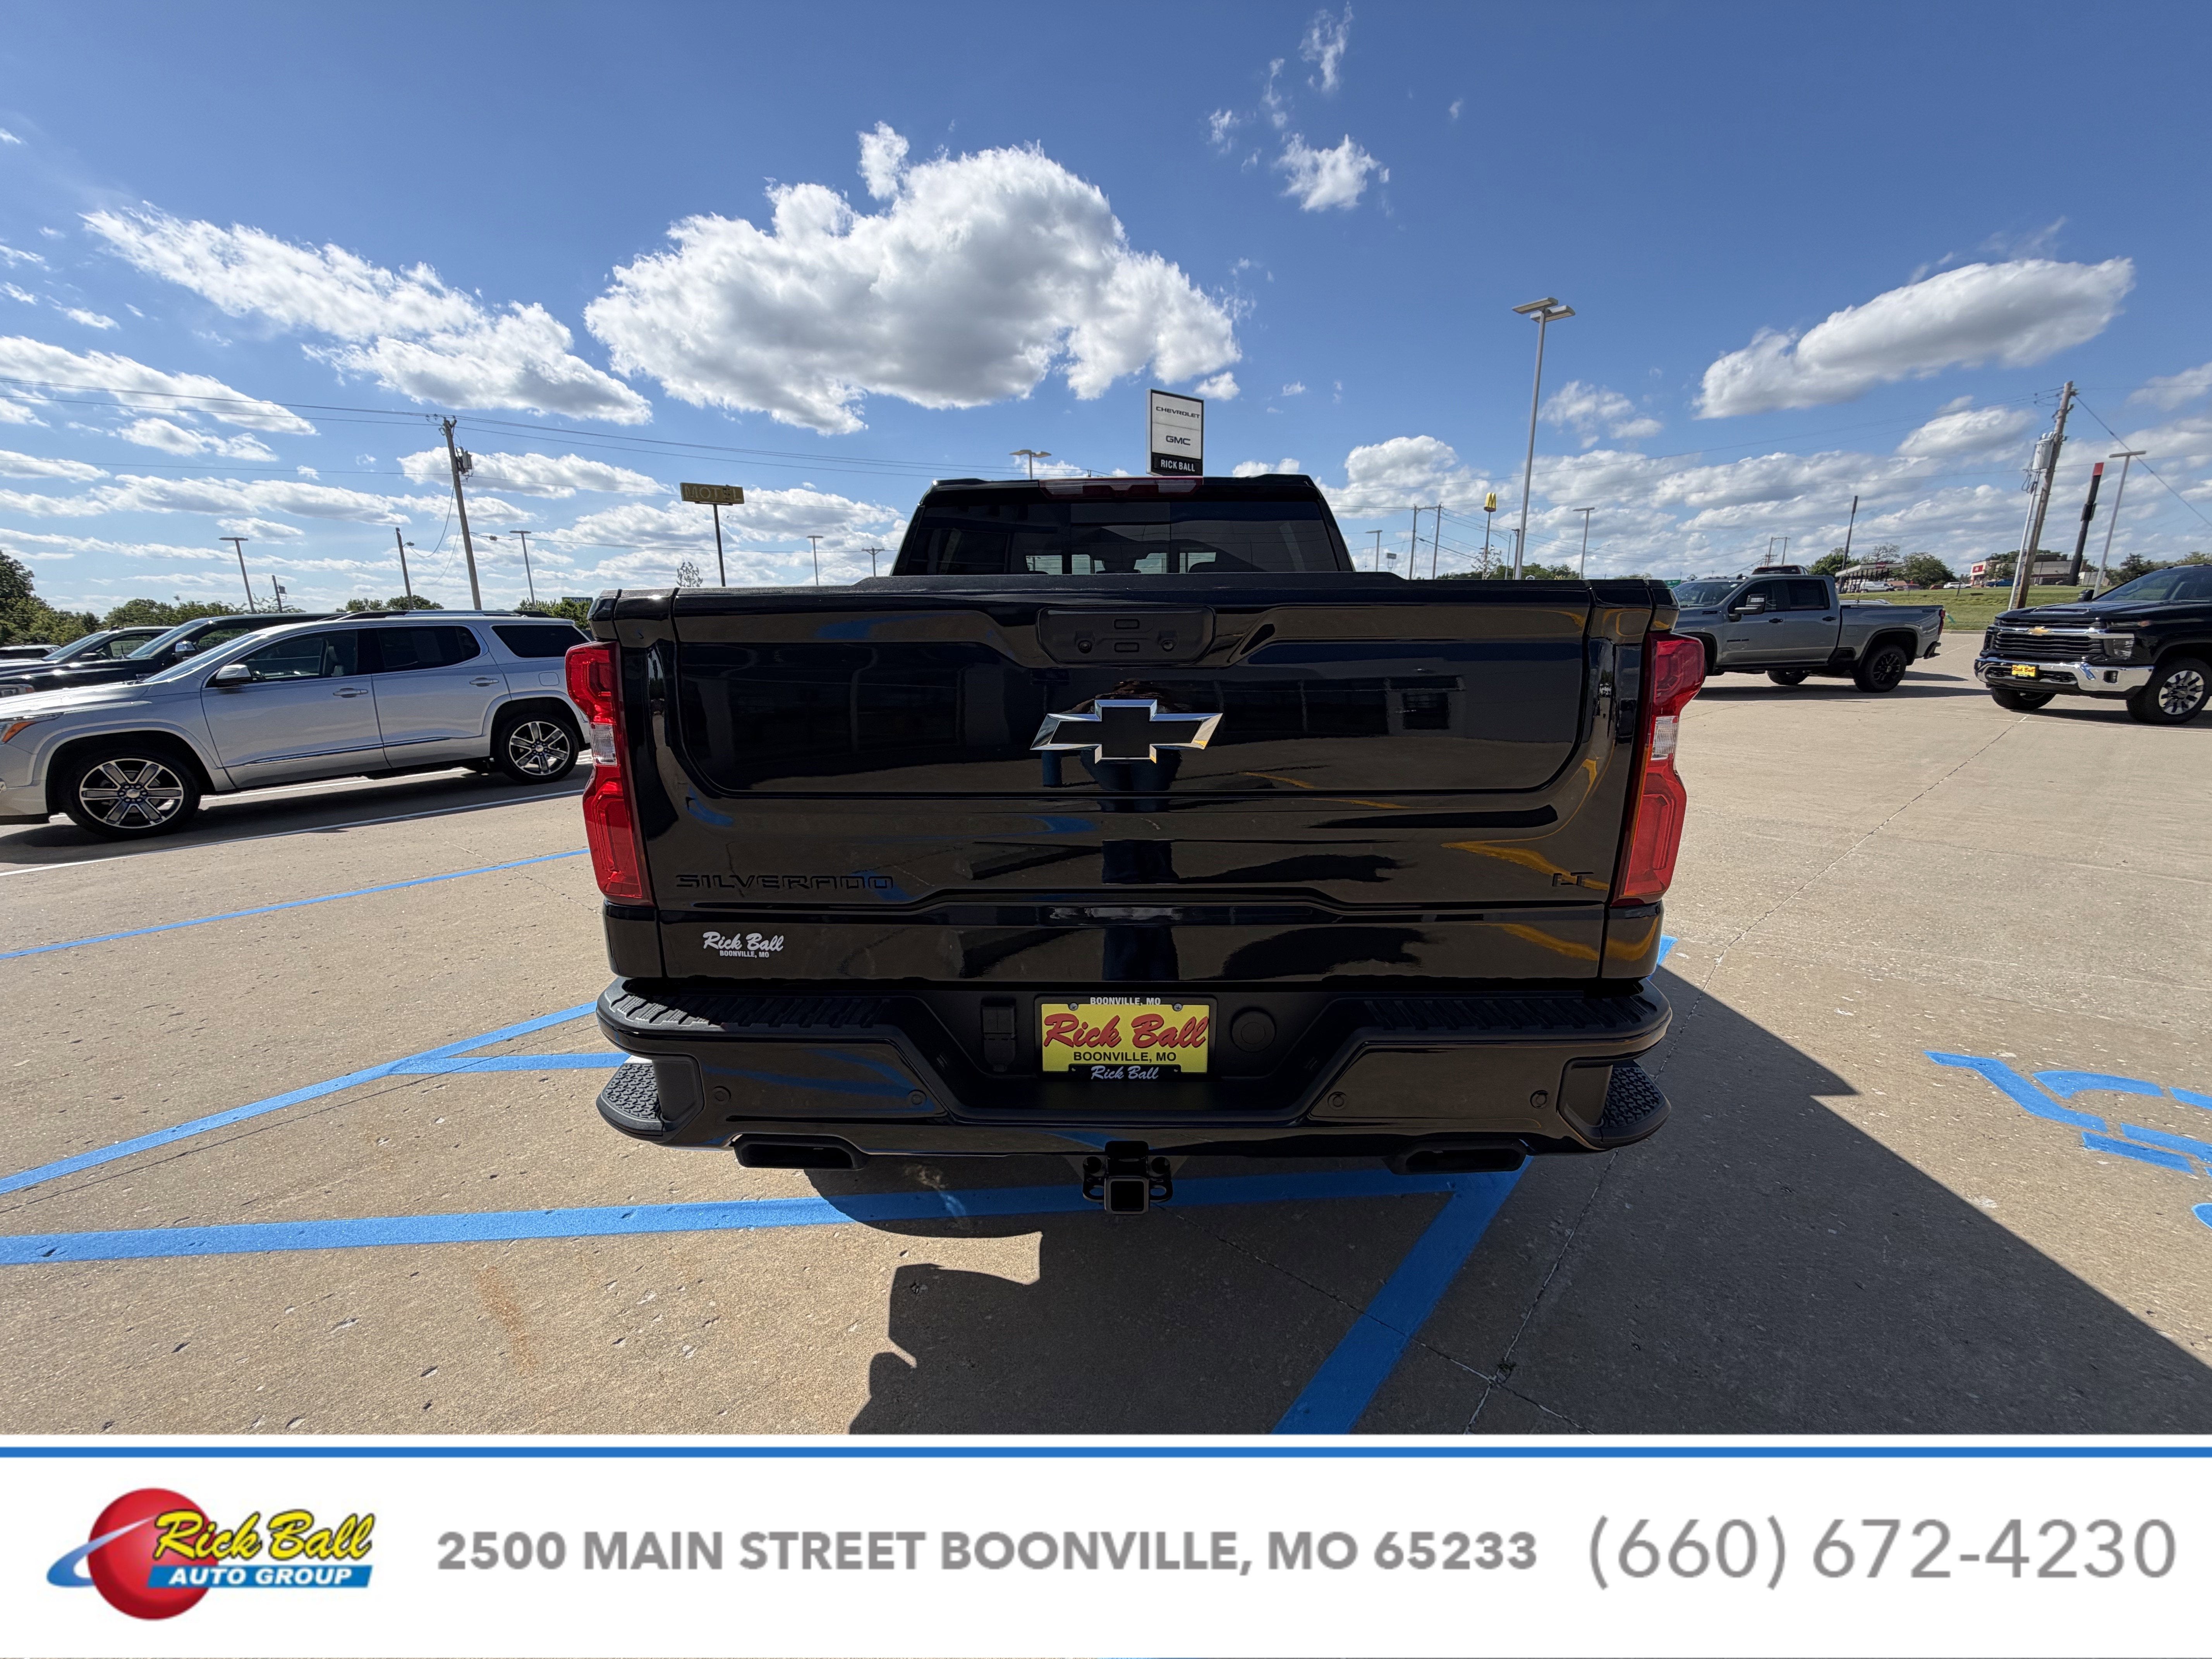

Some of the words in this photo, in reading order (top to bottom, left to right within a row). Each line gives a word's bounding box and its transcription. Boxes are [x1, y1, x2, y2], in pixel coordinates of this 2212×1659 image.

[1156, 406, 1200, 418] CHEVROLET
[1166, 435, 1191, 445] GMC
[1161, 459, 1177, 469] RICK
[1179, 462, 1195, 472] BALL
[685, 485, 742, 501] MOTL
[676, 874, 893, 890] SILVERADO
[702, 931, 742, 950] Rick
[746, 933, 784, 952] Ball
[720, 950, 757, 958] BOONVILLE,
[1090, 997, 1143, 1006] BOONVILLE,
[1044, 1013, 1122, 1048] Rick
[1131, 1013, 1209, 1049] Ball
[1073, 1051, 1152, 1063] BOONVILLE,
[1156, 1052, 1176, 1061] MO
[1091, 1065, 1124, 1080] Rick
[1127, 1066, 1159, 1080] Ball
